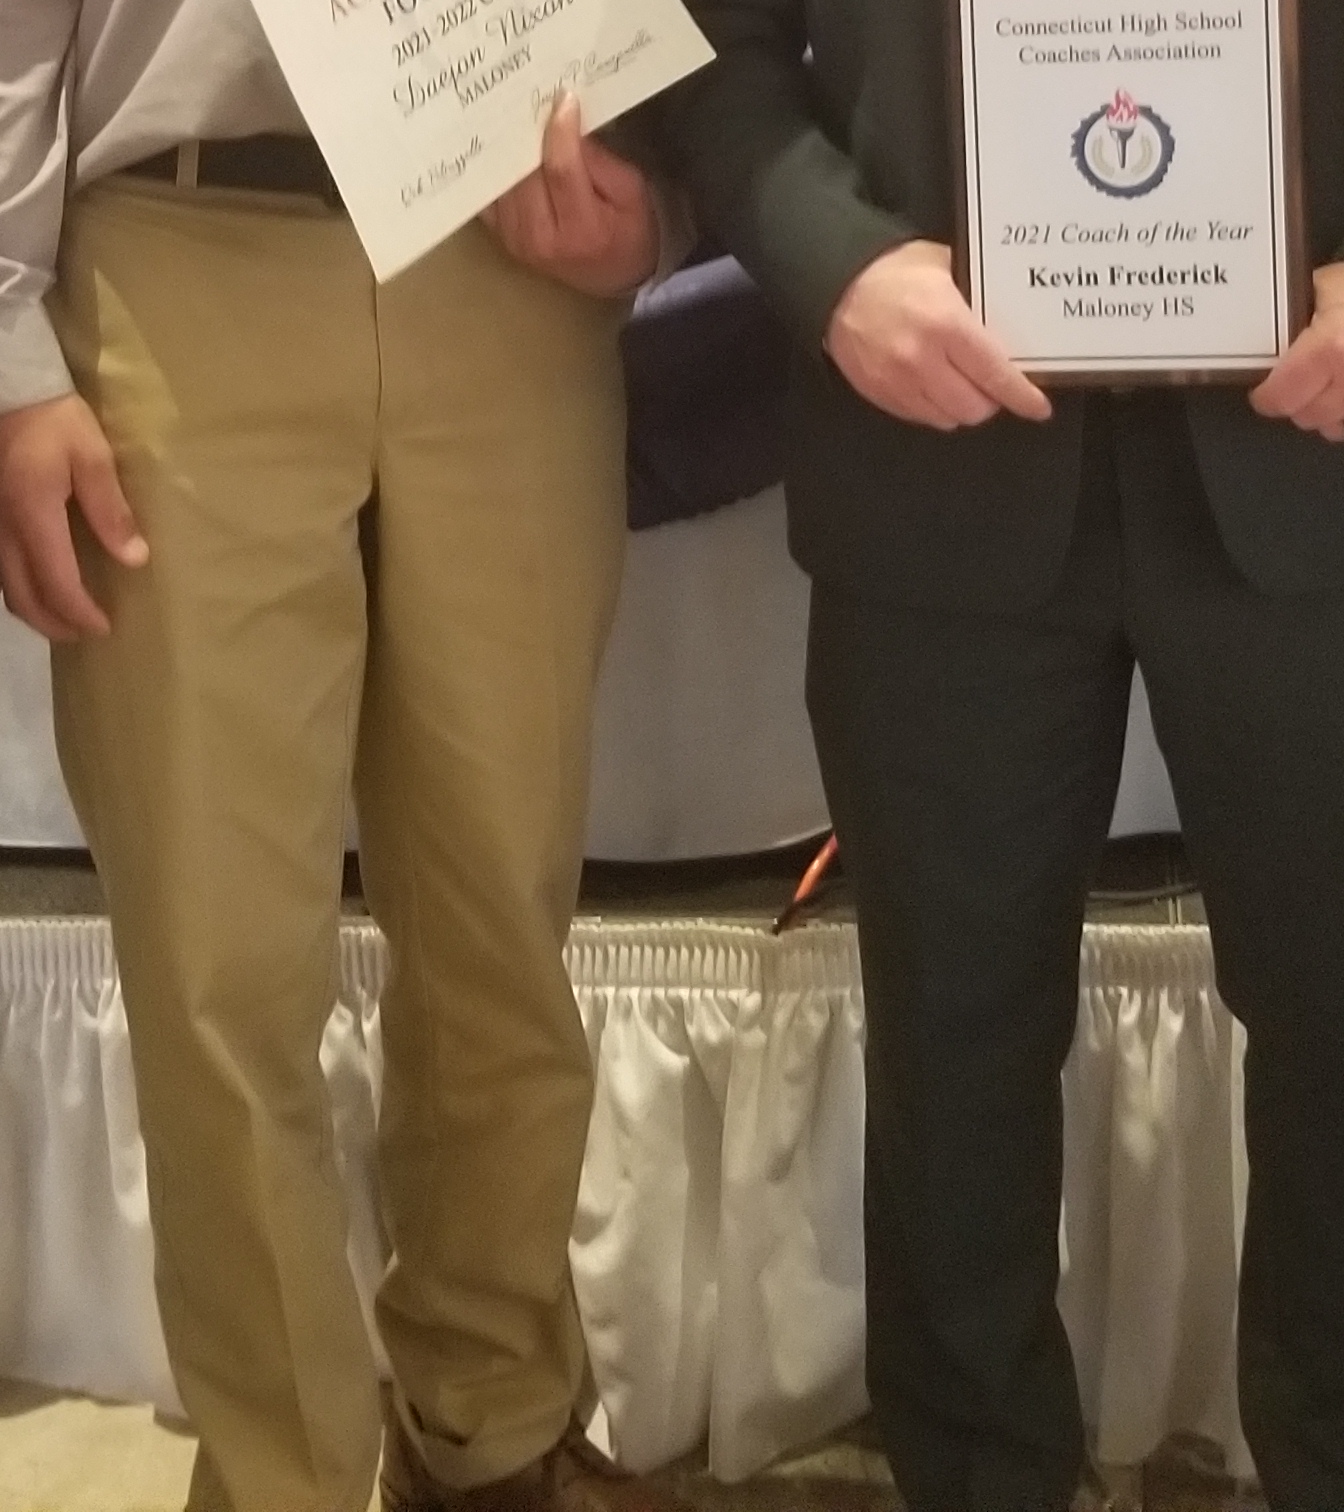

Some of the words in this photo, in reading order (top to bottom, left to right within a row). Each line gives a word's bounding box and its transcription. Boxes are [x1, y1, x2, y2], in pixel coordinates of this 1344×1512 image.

[996, 18, 1112, 37] Connecticut
[1120, 14, 1168, 35] High
[1175, 11, 1243, 31] School
[1019, 45, 1101, 64] Coaches
[1107, 42, 1222, 61] Association
[458, 44, 533, 109] MALONEY
[1000, 225, 1051, 246] 2021
[1061, 223, 1129, 243] Coach
[1137, 222, 1161, 245] of
[1166, 223, 1198, 242] the
[1207, 221, 1253, 241] Year
[1028, 267, 1099, 288] Kevin
[1109, 264, 1228, 286] Frederick
[1063, 298, 1154, 322] Maloney
[1162, 297, 1194, 317] HS
